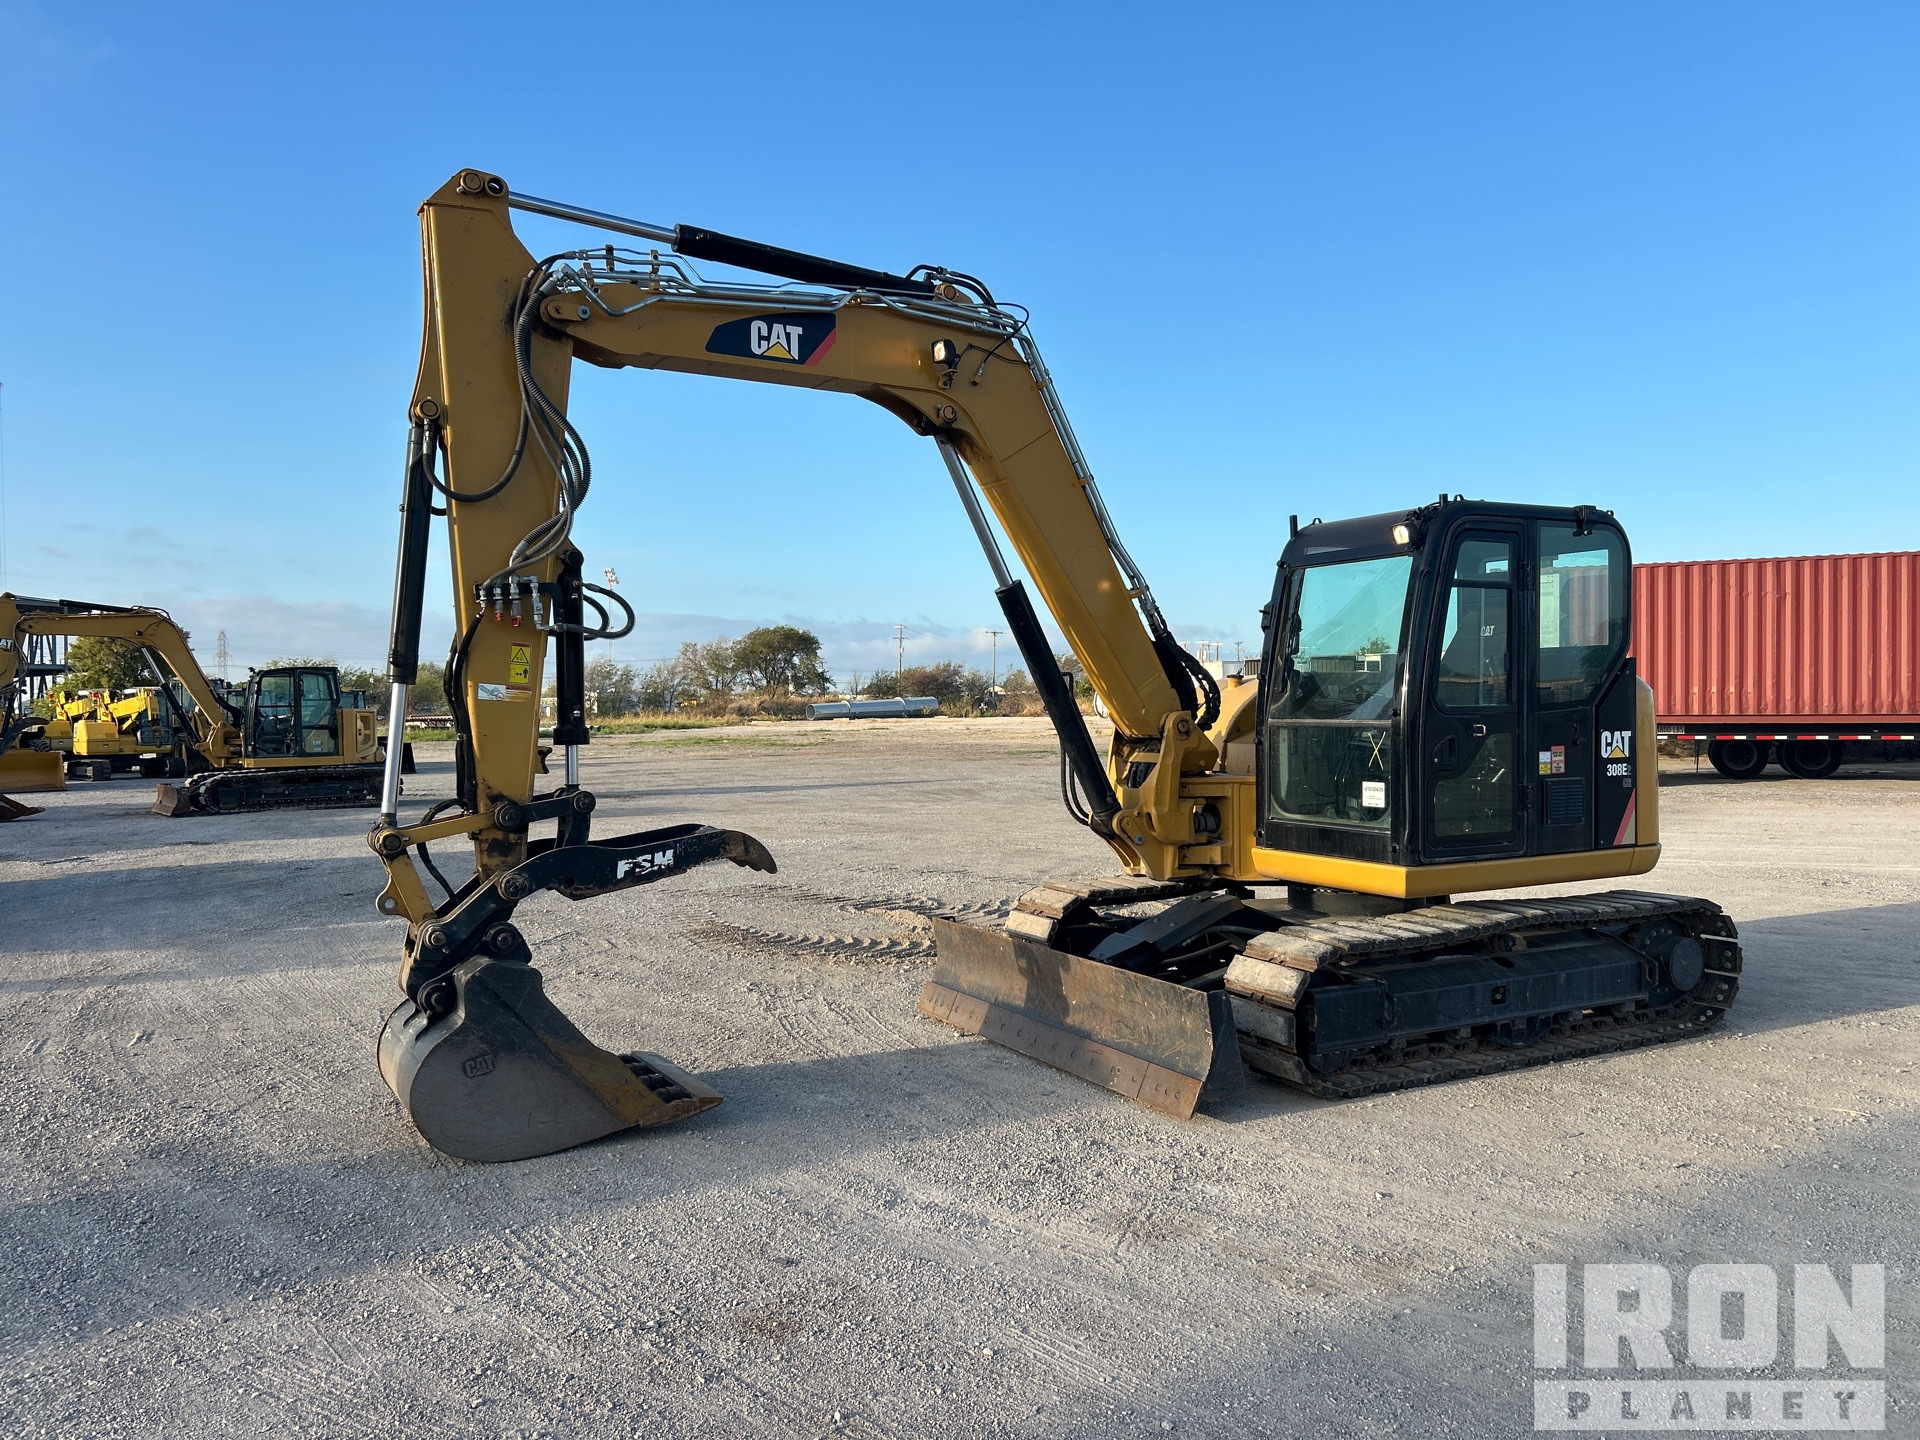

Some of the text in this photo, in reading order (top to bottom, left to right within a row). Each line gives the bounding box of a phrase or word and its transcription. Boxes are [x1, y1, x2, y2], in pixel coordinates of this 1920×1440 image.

[751, 320, 803, 360] CAT
[1481, 625, 1495, 636] CAT
[0, 638, 13, 650] AT
[1601, 730, 1631, 758] CAT
[616, 849, 674, 879] FSM
[463, 1054, 494, 1078] CAT
